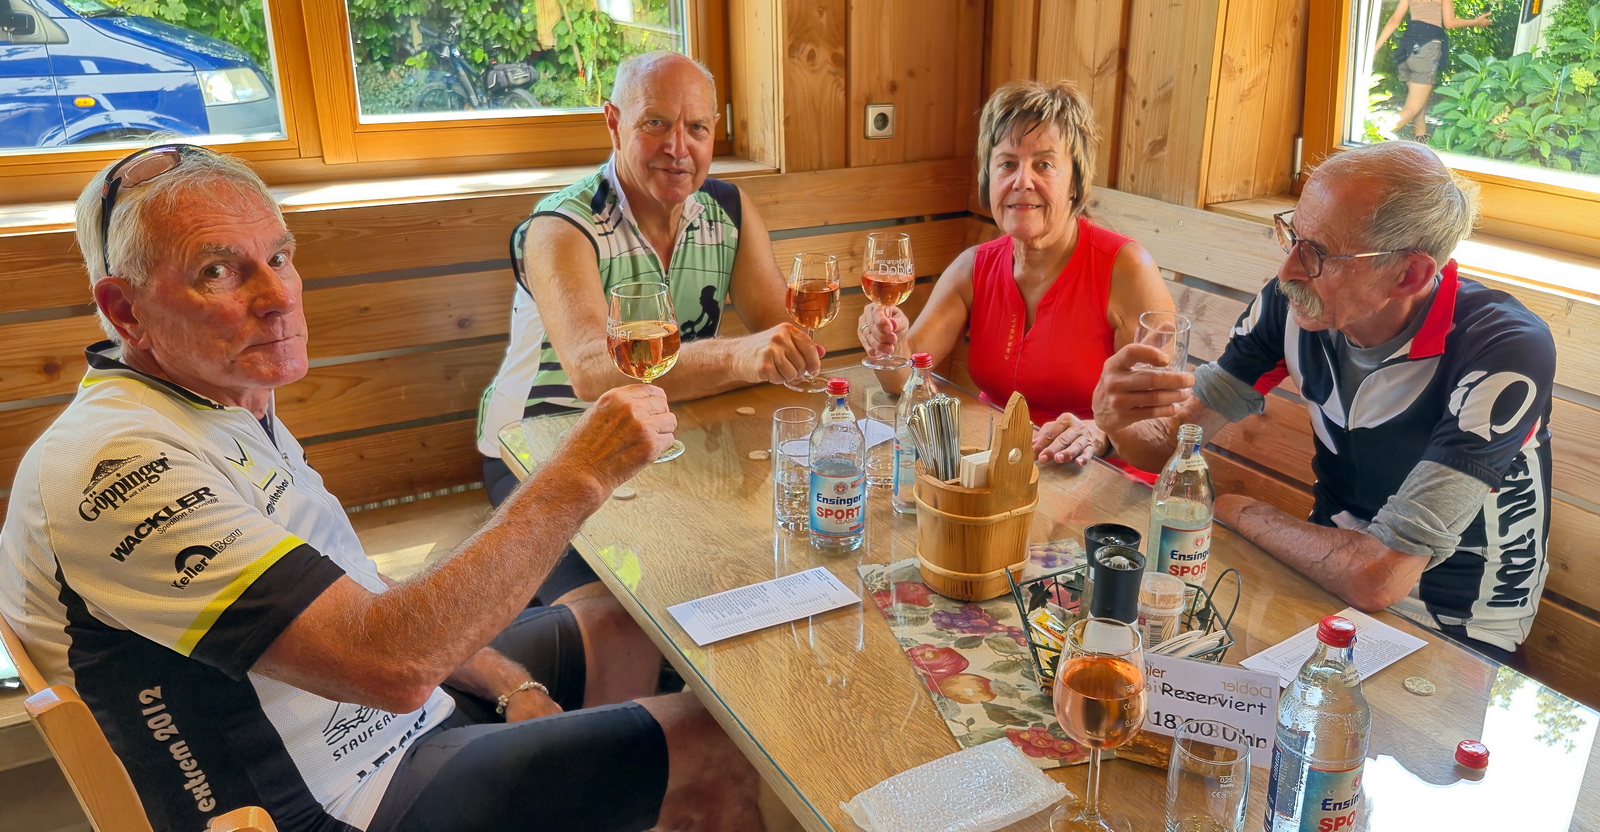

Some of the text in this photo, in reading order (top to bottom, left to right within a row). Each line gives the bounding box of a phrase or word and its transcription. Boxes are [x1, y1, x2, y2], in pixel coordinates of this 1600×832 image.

[78, 456, 173, 522] Göppinger
[816, 492, 863, 507] Ensinger
[816, 505, 862, 520] SPORT
[110, 486, 217, 563] WACKLER
[171, 557, 209, 591] Keller
[1168, 561, 1207, 577] SPOR
[1161, 682, 1268, 716] Reserviert
[1222, 726, 1267, 749] Uhr
[138, 686, 217, 813] extrem 2012
[1320, 793, 1360, 811] Ensin
[1317, 810, 1357, 832] SPO
